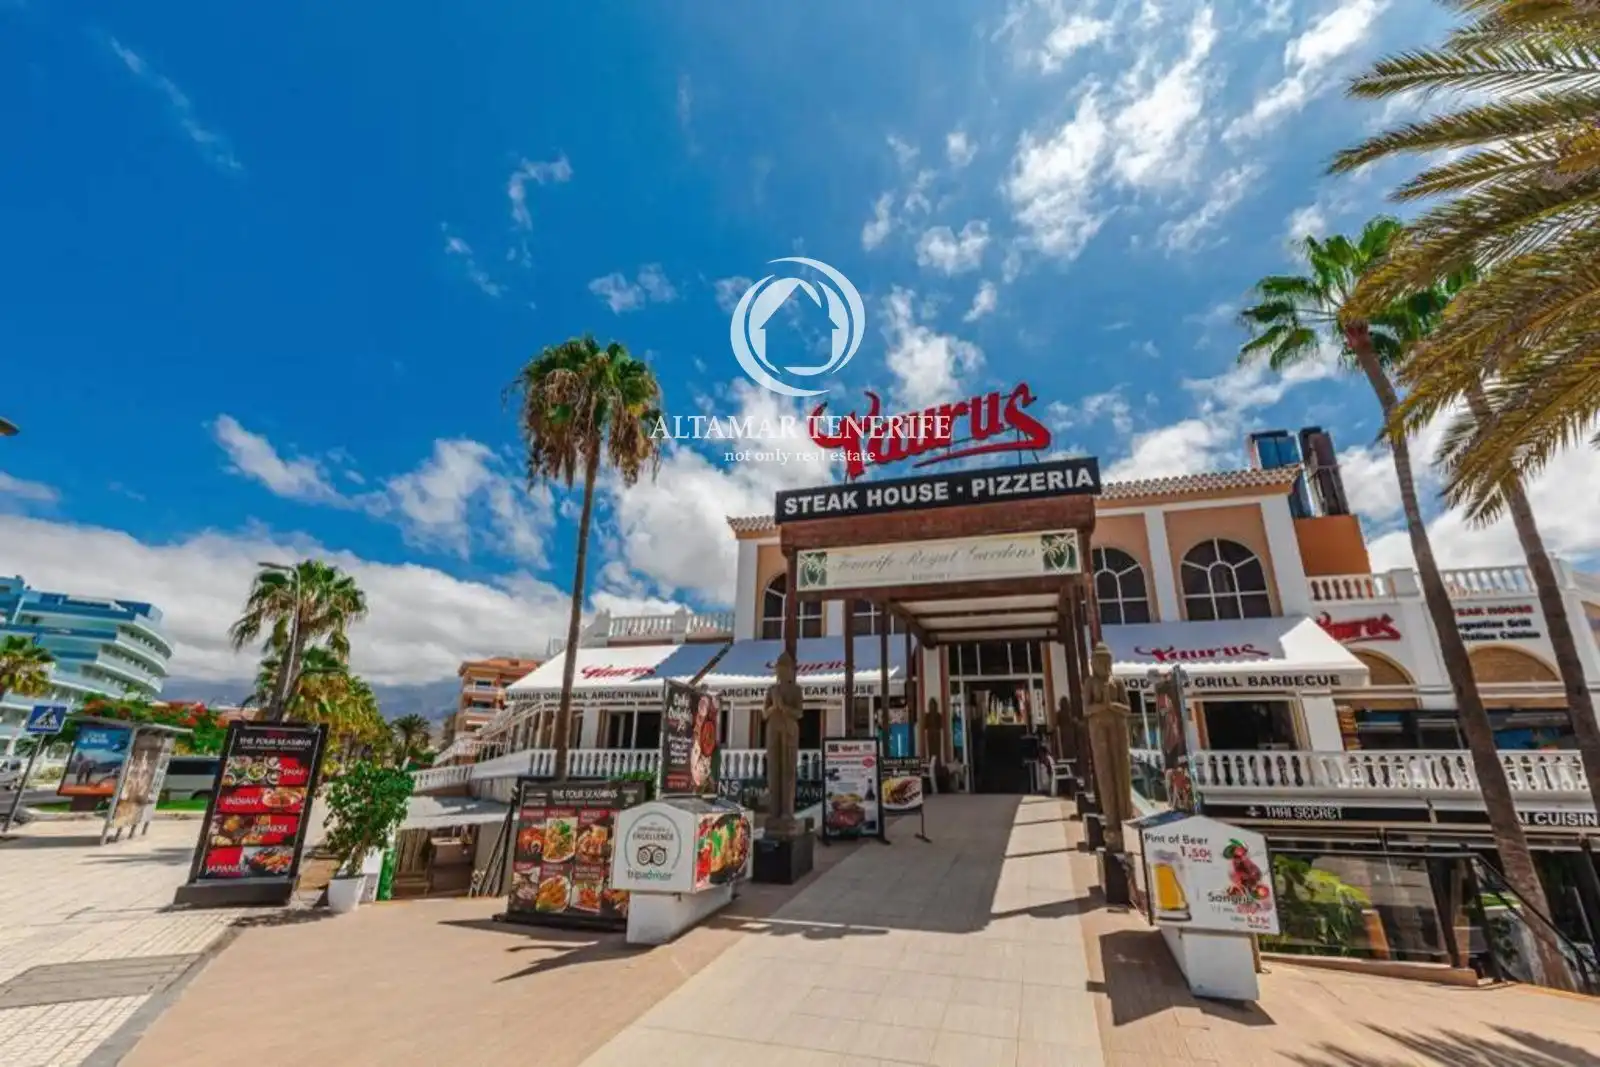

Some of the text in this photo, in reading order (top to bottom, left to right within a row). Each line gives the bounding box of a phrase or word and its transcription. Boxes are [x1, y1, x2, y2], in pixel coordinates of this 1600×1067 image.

[808, 382, 1053, 479] Taurus
[784, 467, 1095, 516] STEAK HOUSE PIZZERIA
[1194, 676, 1243, 688] GRILL
[1247, 674, 1342, 687] BARBECUE
[803, 685, 829, 696] EAK
[1533, 811, 1599, 826] CUISIN
[1144, 833, 1209, 844] Pint of Beer
